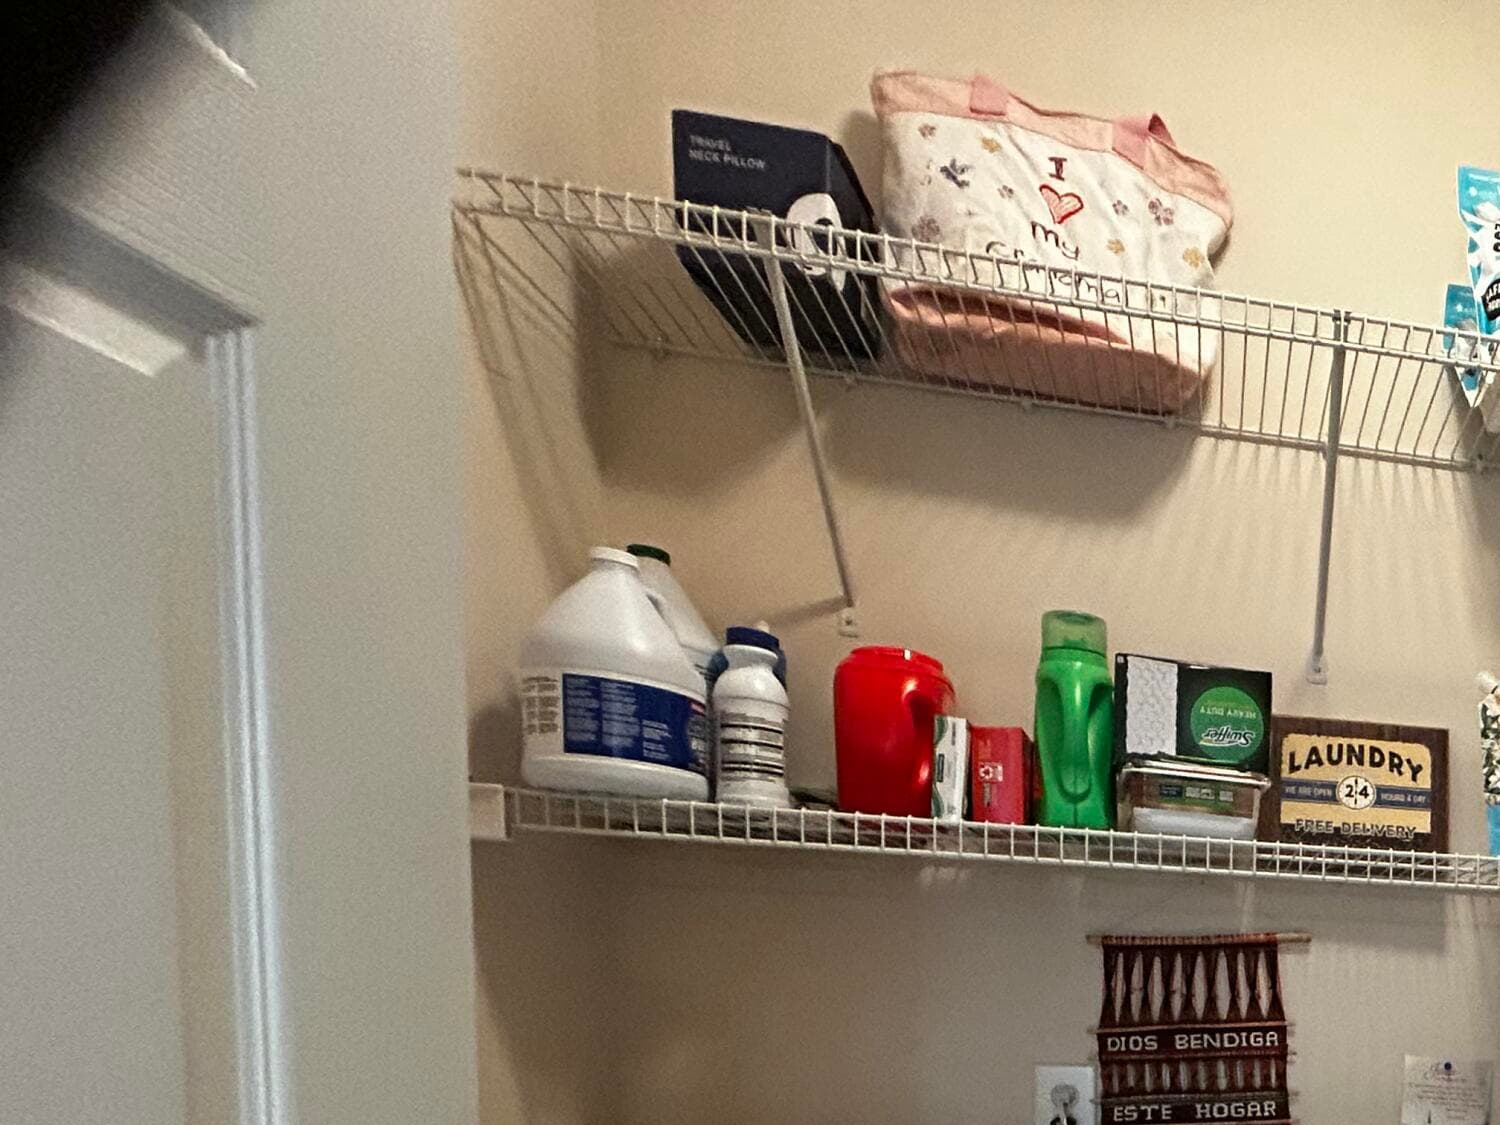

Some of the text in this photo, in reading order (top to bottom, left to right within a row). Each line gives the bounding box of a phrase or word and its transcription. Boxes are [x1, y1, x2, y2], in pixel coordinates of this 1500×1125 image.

[688, 149, 766, 170] NECK PILLOW
[1201, 725, 1256, 747] Swiffer
[1288, 743, 1423, 783] LAUNDRY
[1344, 784, 1369, 799] 24
[1294, 818, 1417, 839] FREE DELIVERY
[1107, 1031, 1280, 1051] DIOS BENDIGA
[1113, 1100, 1277, 1122] ESTE HOGAR
